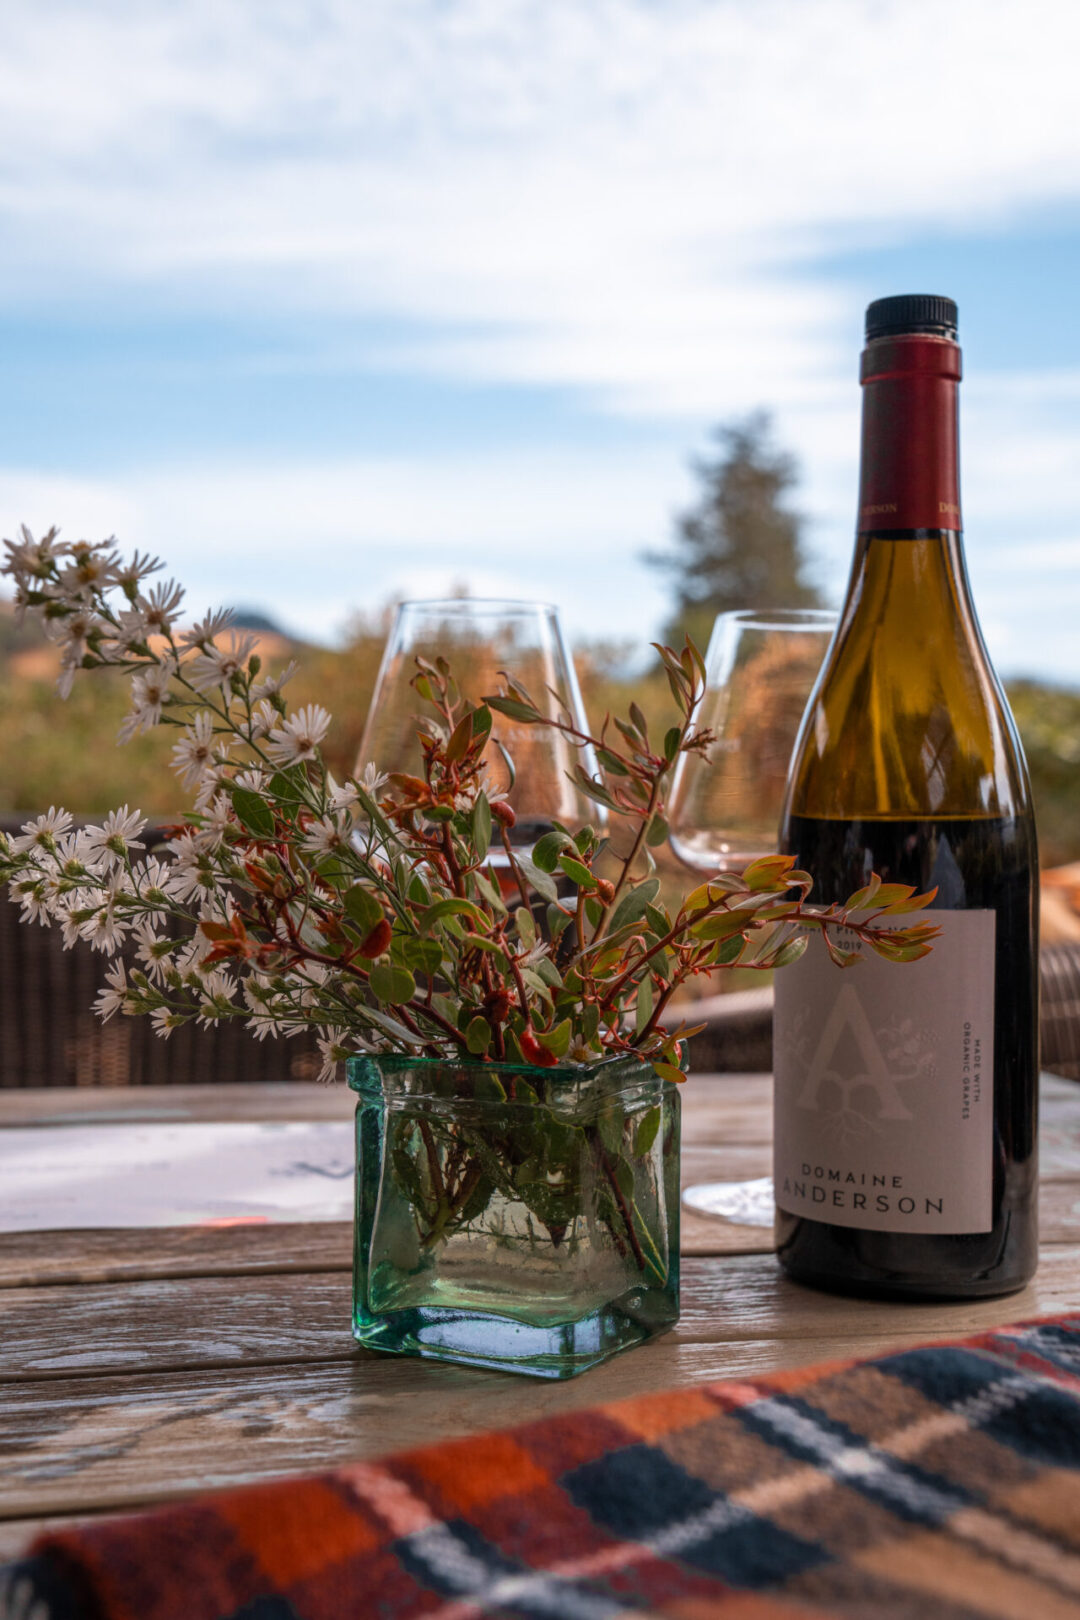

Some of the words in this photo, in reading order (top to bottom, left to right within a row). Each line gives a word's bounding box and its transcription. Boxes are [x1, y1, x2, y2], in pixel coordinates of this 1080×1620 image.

[837, 941, 863, 951] 2019
[962, 1021, 972, 1073] ORGANIC
[973, 1039, 982, 1069] MADE
[961, 1077, 971, 1120] GRAPES
[973, 1073, 982, 1103] WITH
[801, 1163, 904, 1189] DOMAINE
[782, 1177, 945, 1215] ANDERSON
